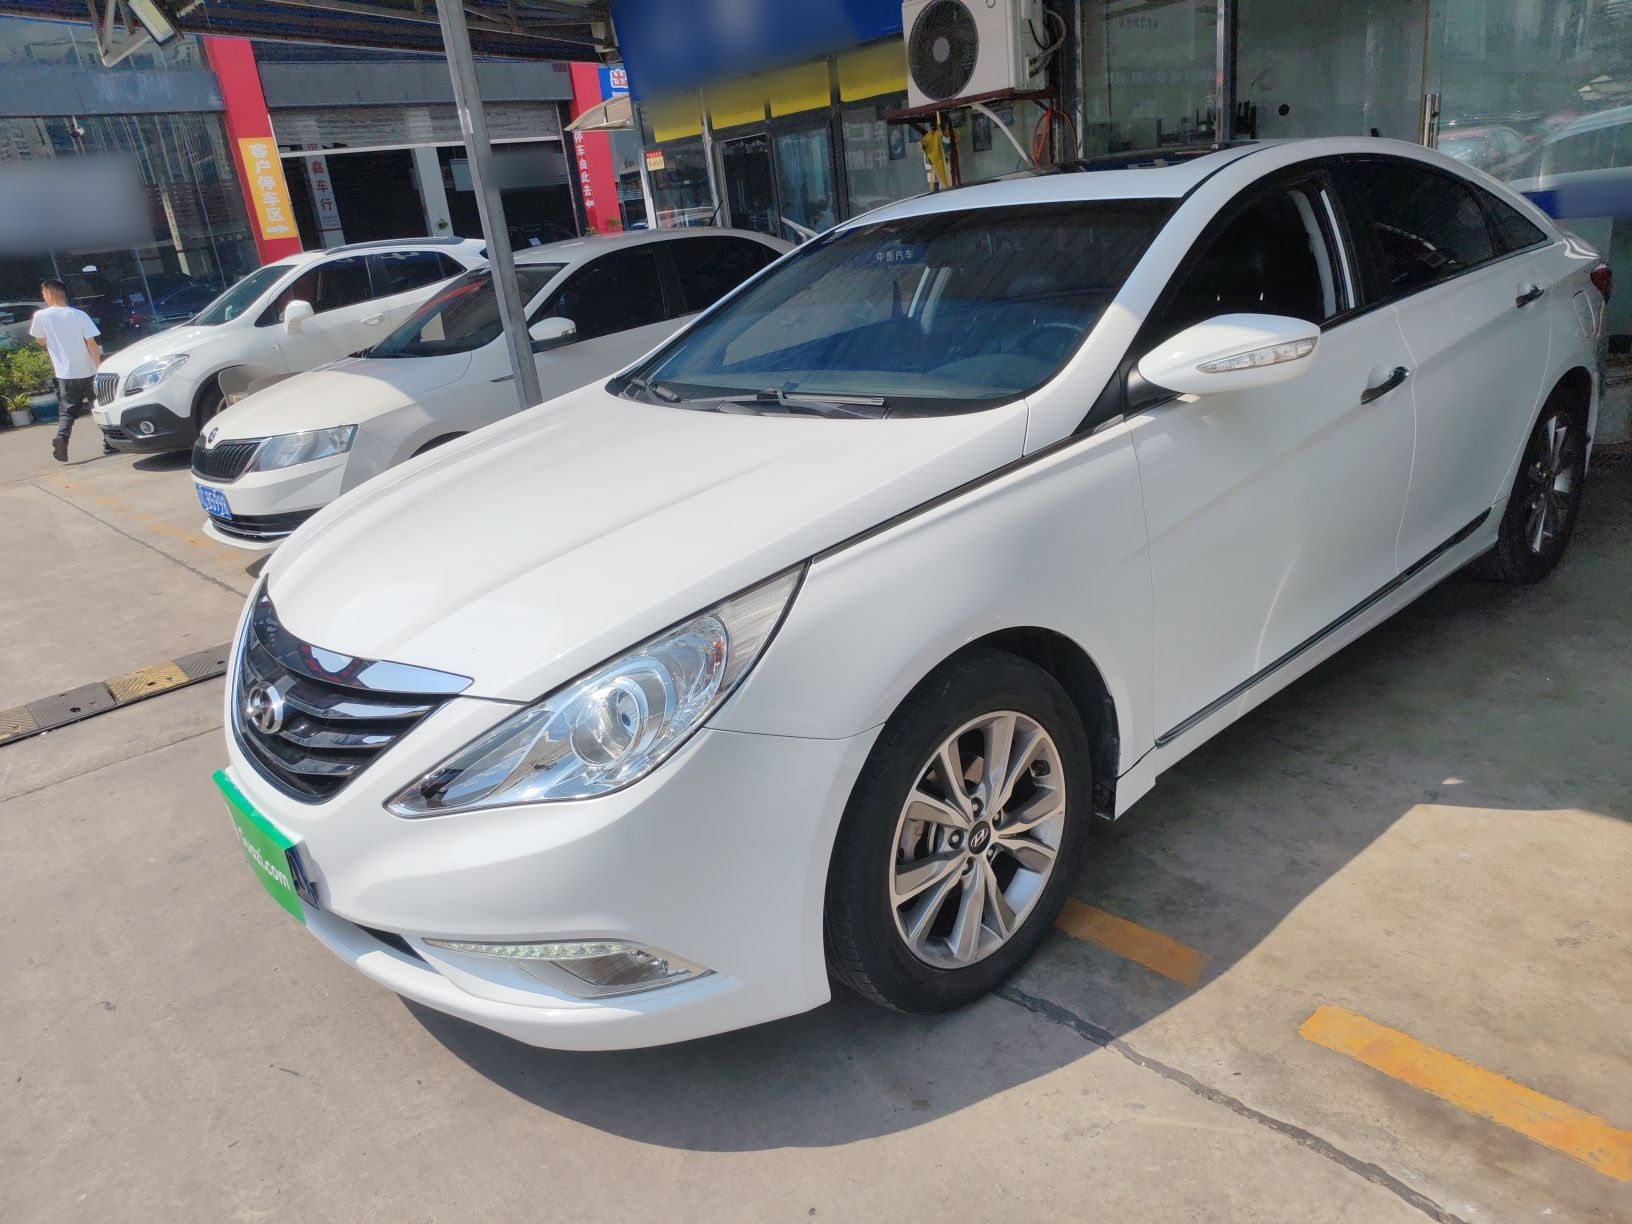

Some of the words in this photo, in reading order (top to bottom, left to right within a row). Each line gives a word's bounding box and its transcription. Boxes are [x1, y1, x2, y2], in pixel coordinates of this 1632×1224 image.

[249, 143, 285, 222] 客户停车区
